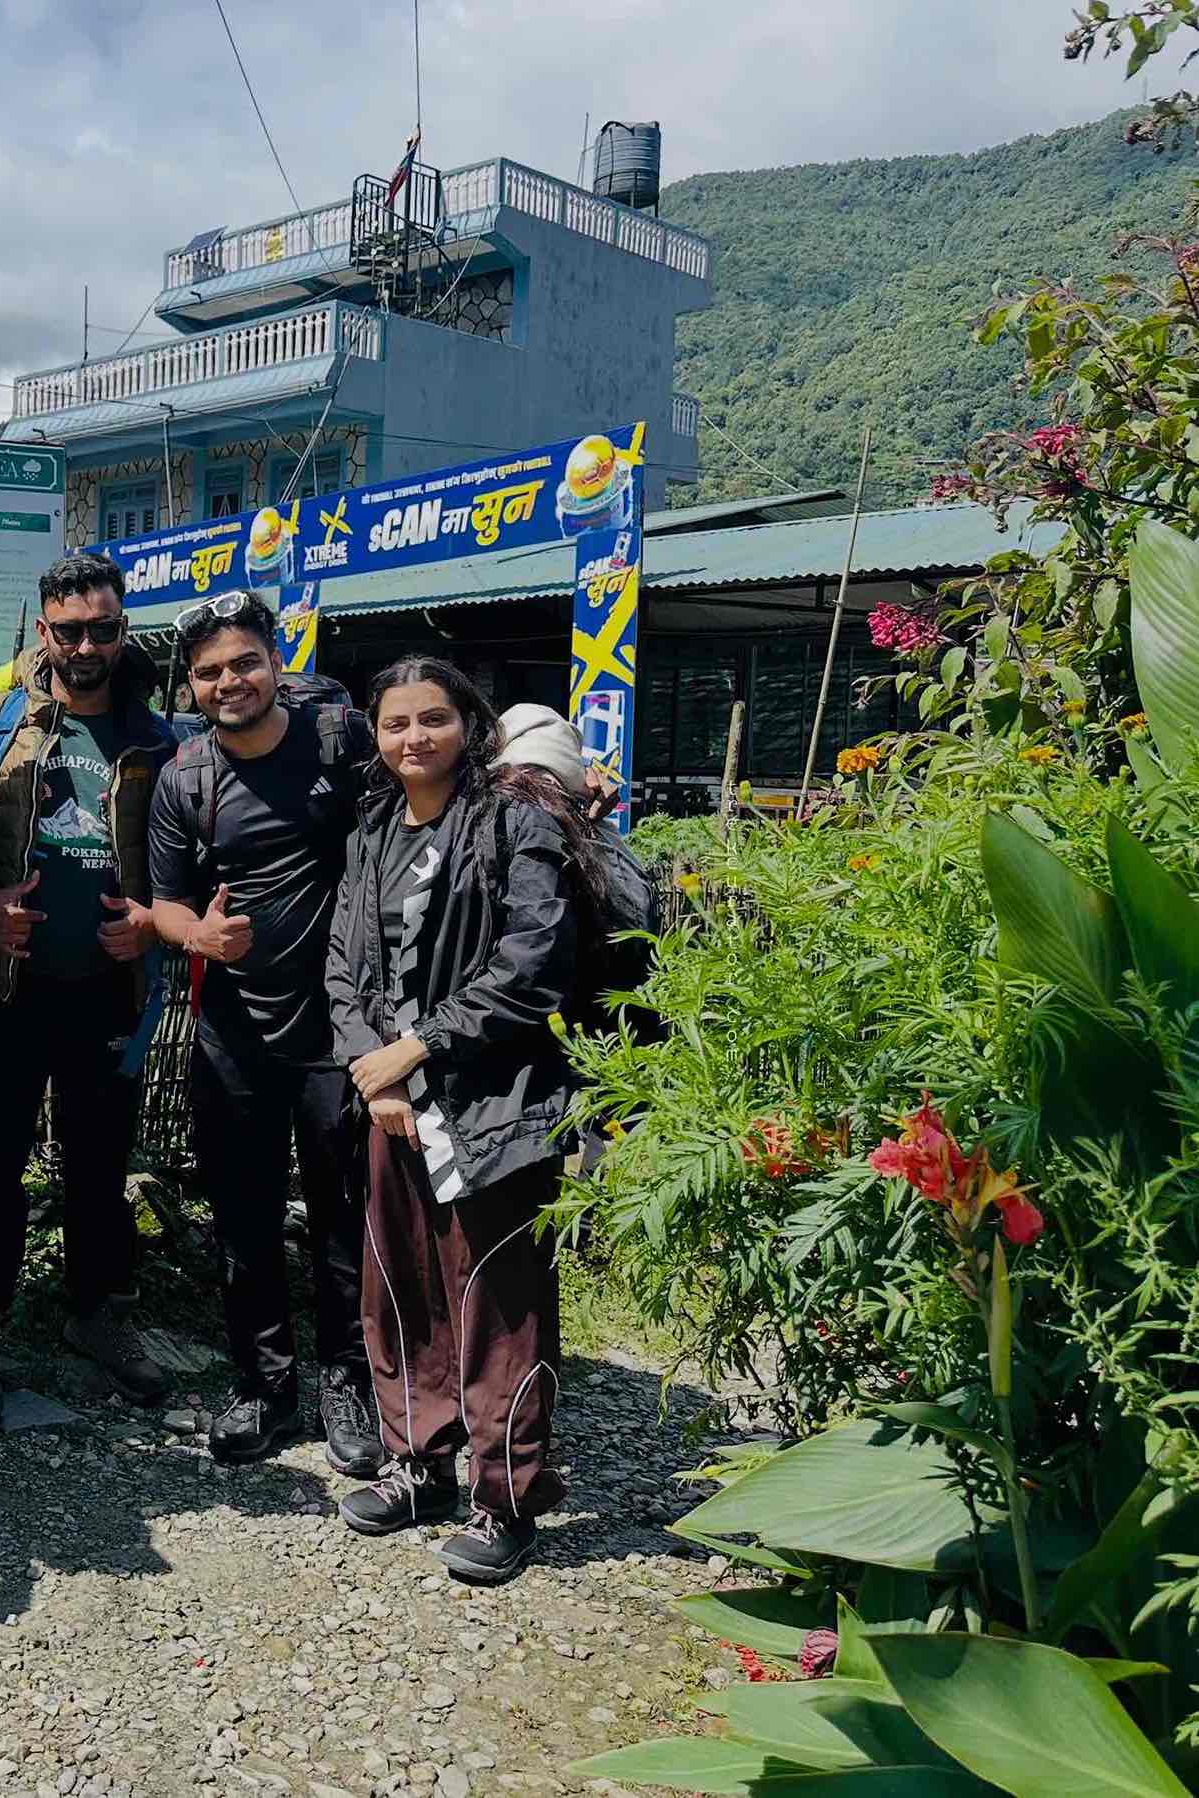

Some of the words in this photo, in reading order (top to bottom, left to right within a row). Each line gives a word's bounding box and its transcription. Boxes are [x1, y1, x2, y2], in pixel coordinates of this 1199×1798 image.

[441, 506, 472, 534] मा
[471, 480, 546, 546] सुन
[172, 558, 191, 581] मा
[190, 541, 239, 593] सुन
[304, 540, 349, 564] XTREME
